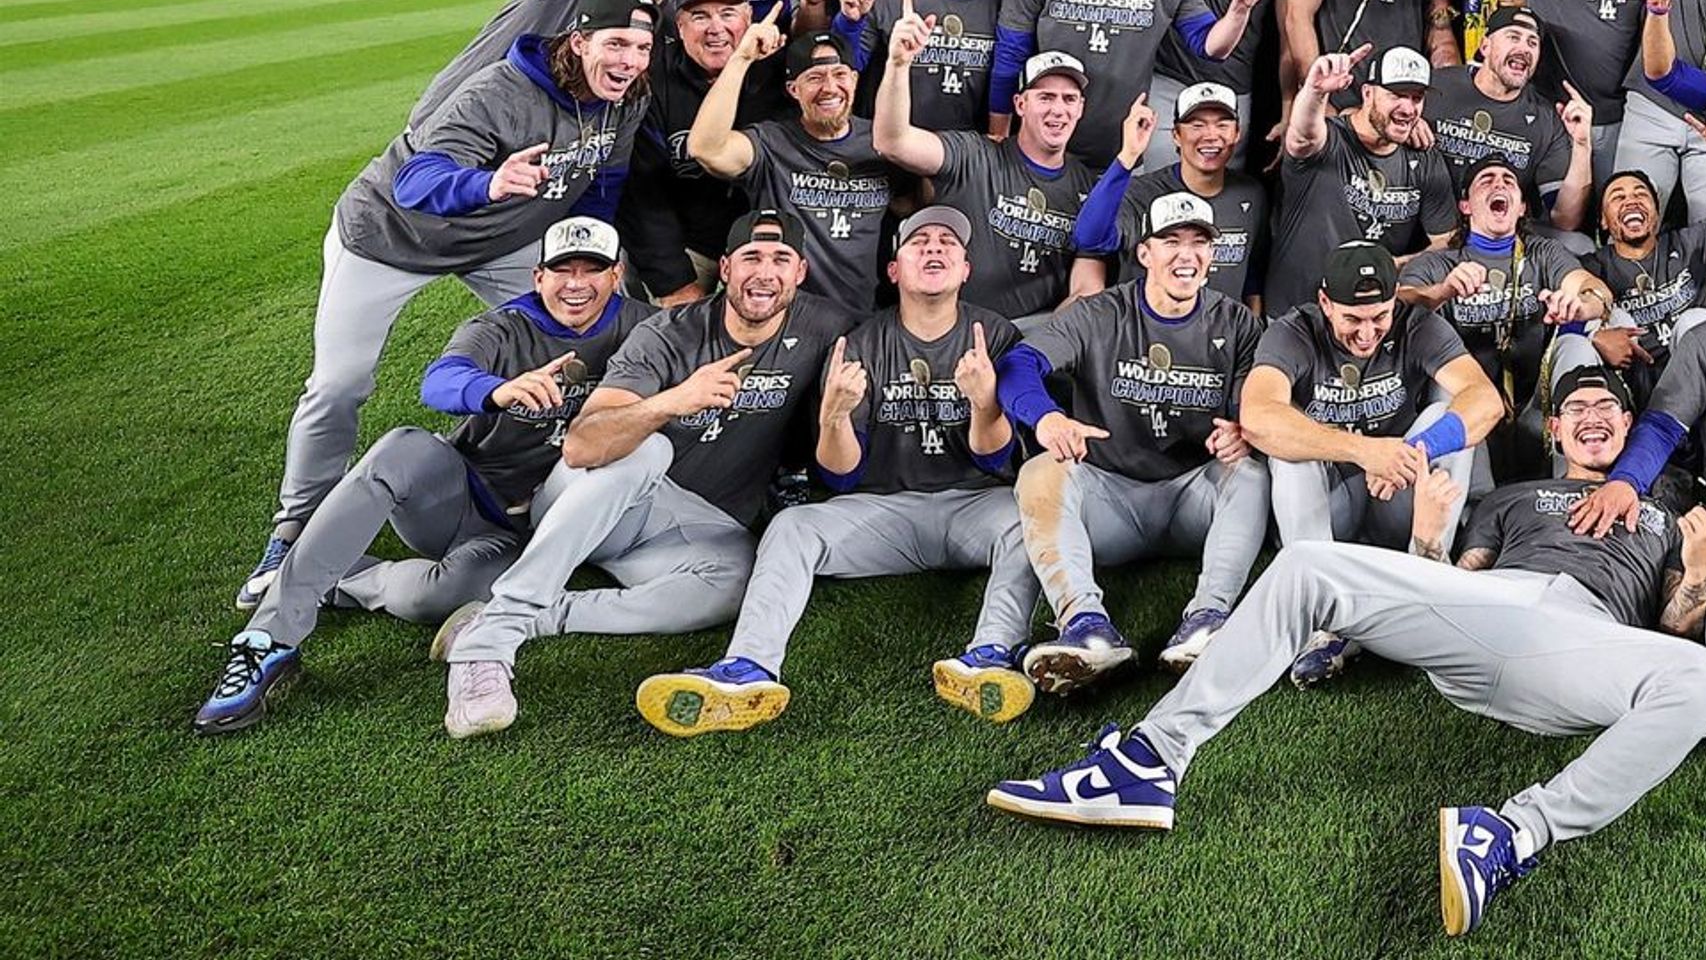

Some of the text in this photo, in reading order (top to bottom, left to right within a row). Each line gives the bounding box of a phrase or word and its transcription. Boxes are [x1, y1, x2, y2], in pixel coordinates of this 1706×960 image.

[1049, 2, 1154, 28] CHAMPIONS
[1436, 120, 1532, 154] WORLD SERIES
[790, 172, 890, 192] WORLD SERIES
[1168, 368, 1225, 387] SERIES
[1312, 376, 1403, 403] WORLD SERIES
[882, 385, 927, 402] WORLD
[1112, 378, 1223, 410] CHAMPIONS
